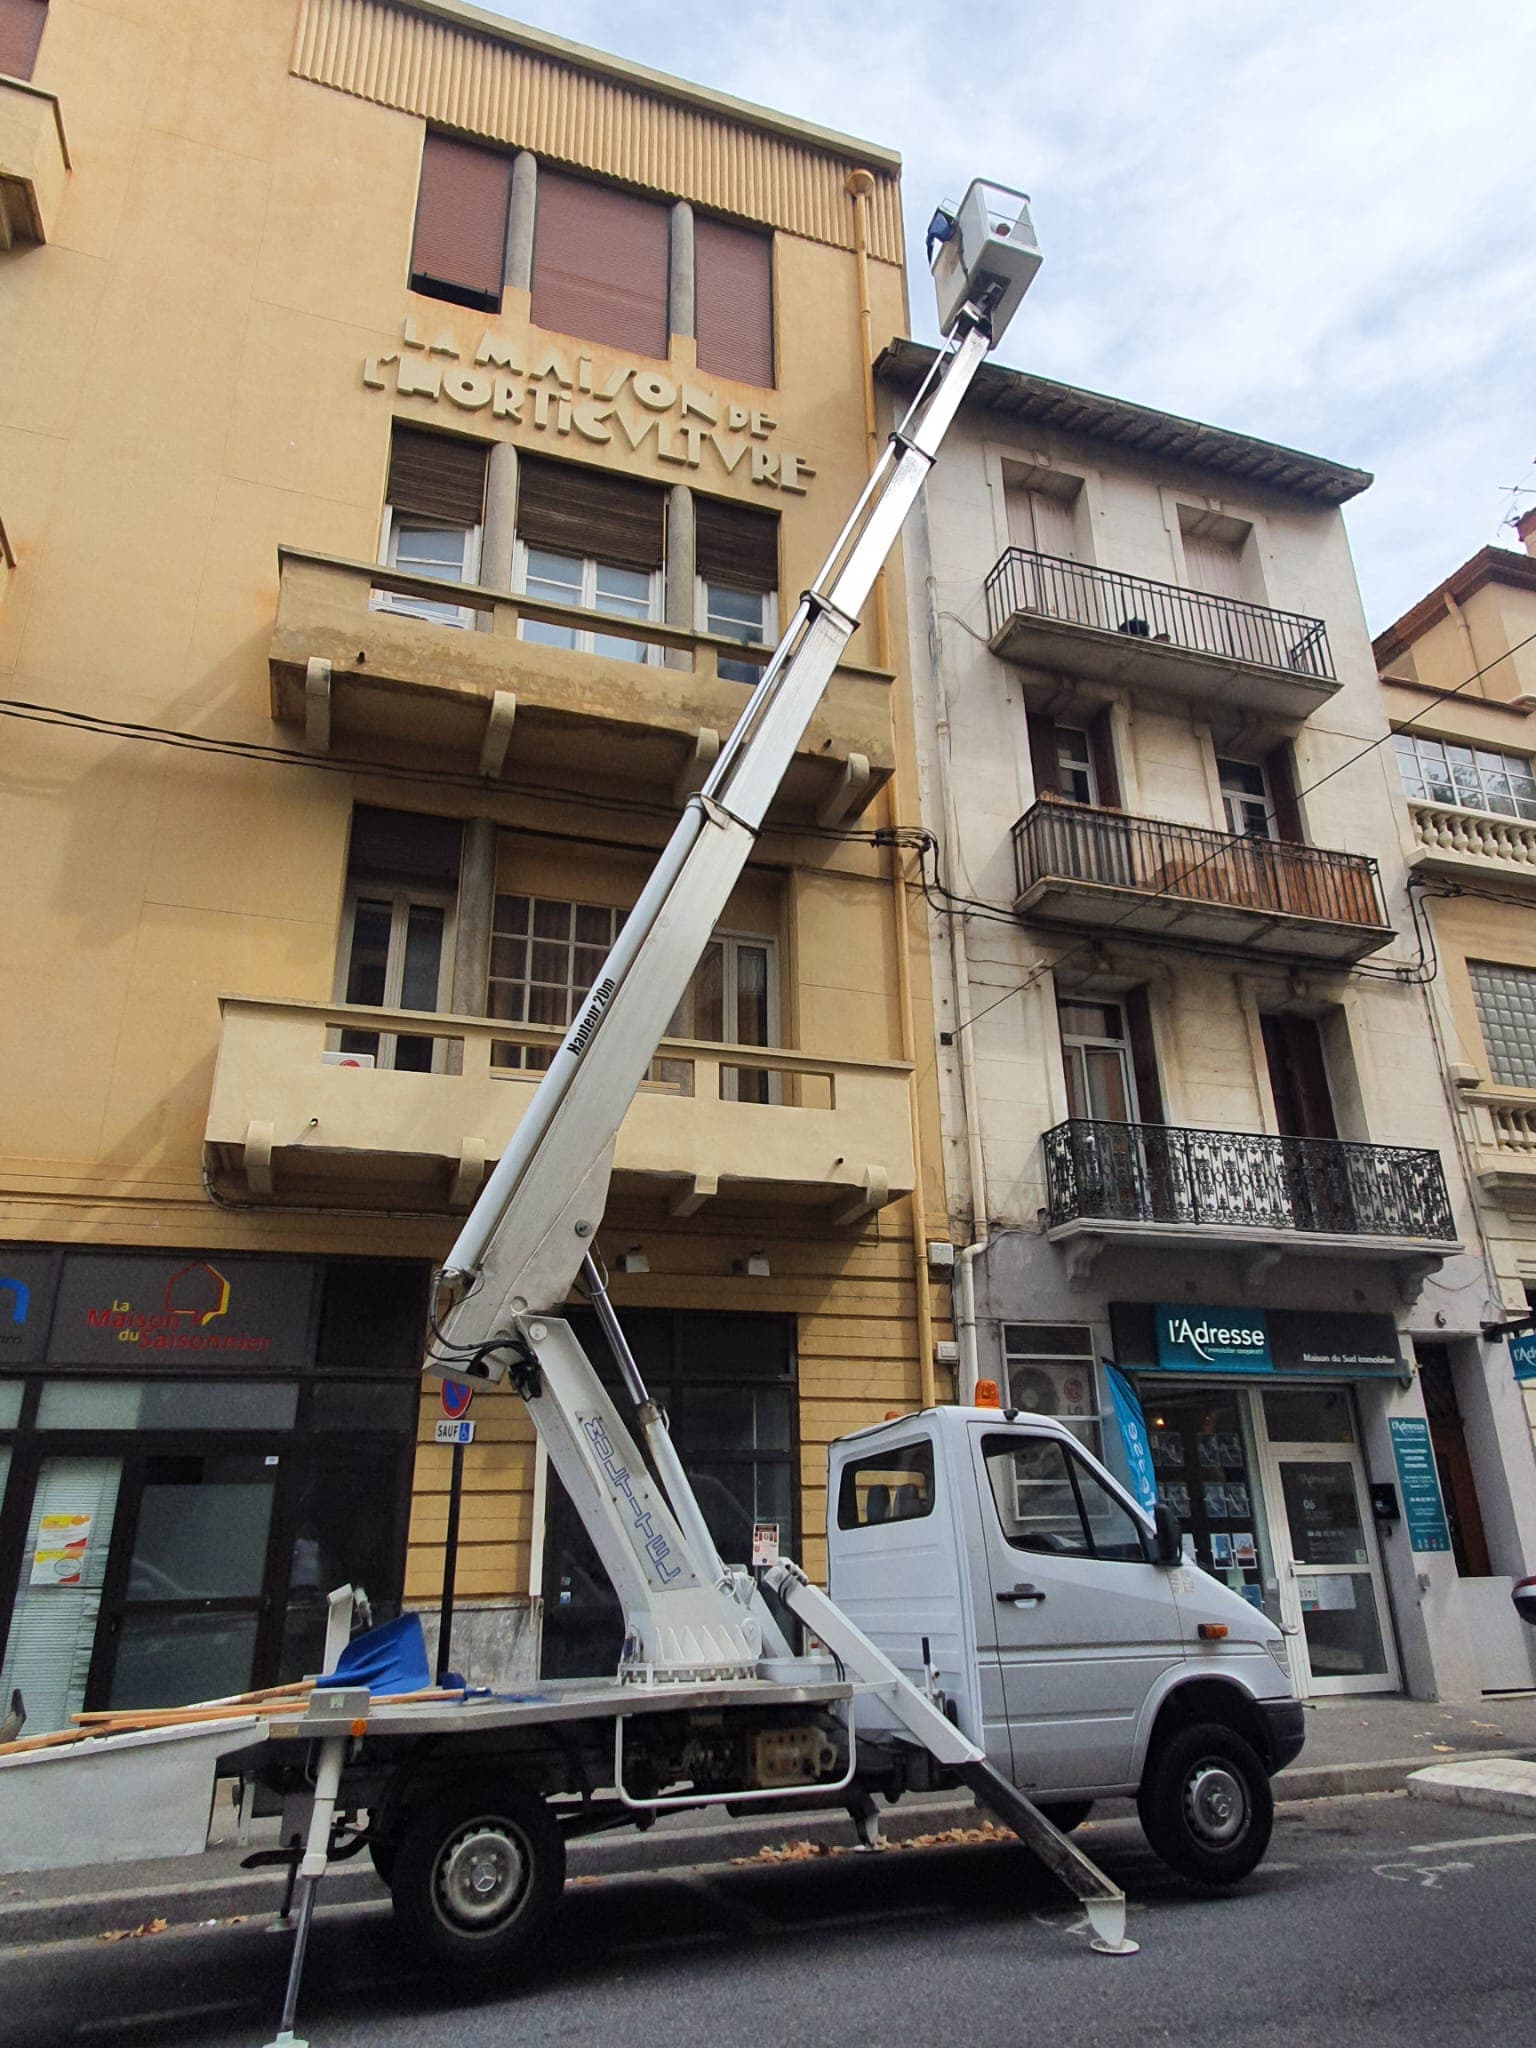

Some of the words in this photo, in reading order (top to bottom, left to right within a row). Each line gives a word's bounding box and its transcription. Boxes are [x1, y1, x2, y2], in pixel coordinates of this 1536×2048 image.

[404, 317, 459, 358] LA
[728, 404, 777, 440] DE
[566, 1004, 601, 1057] Hauteur
[592, 978, 616, 1008] 20m
[86, 1307, 179, 1329] Maison
[112, 1299, 130, 1312] La
[118, 1328, 139, 1342] du
[138, 1329, 271, 1352] Saisonnier
[1168, 1318, 1265, 1361] l'Adresse
[437, 1424, 459, 1438] SAUF
[584, 1416, 681, 1585] MULTITEL
